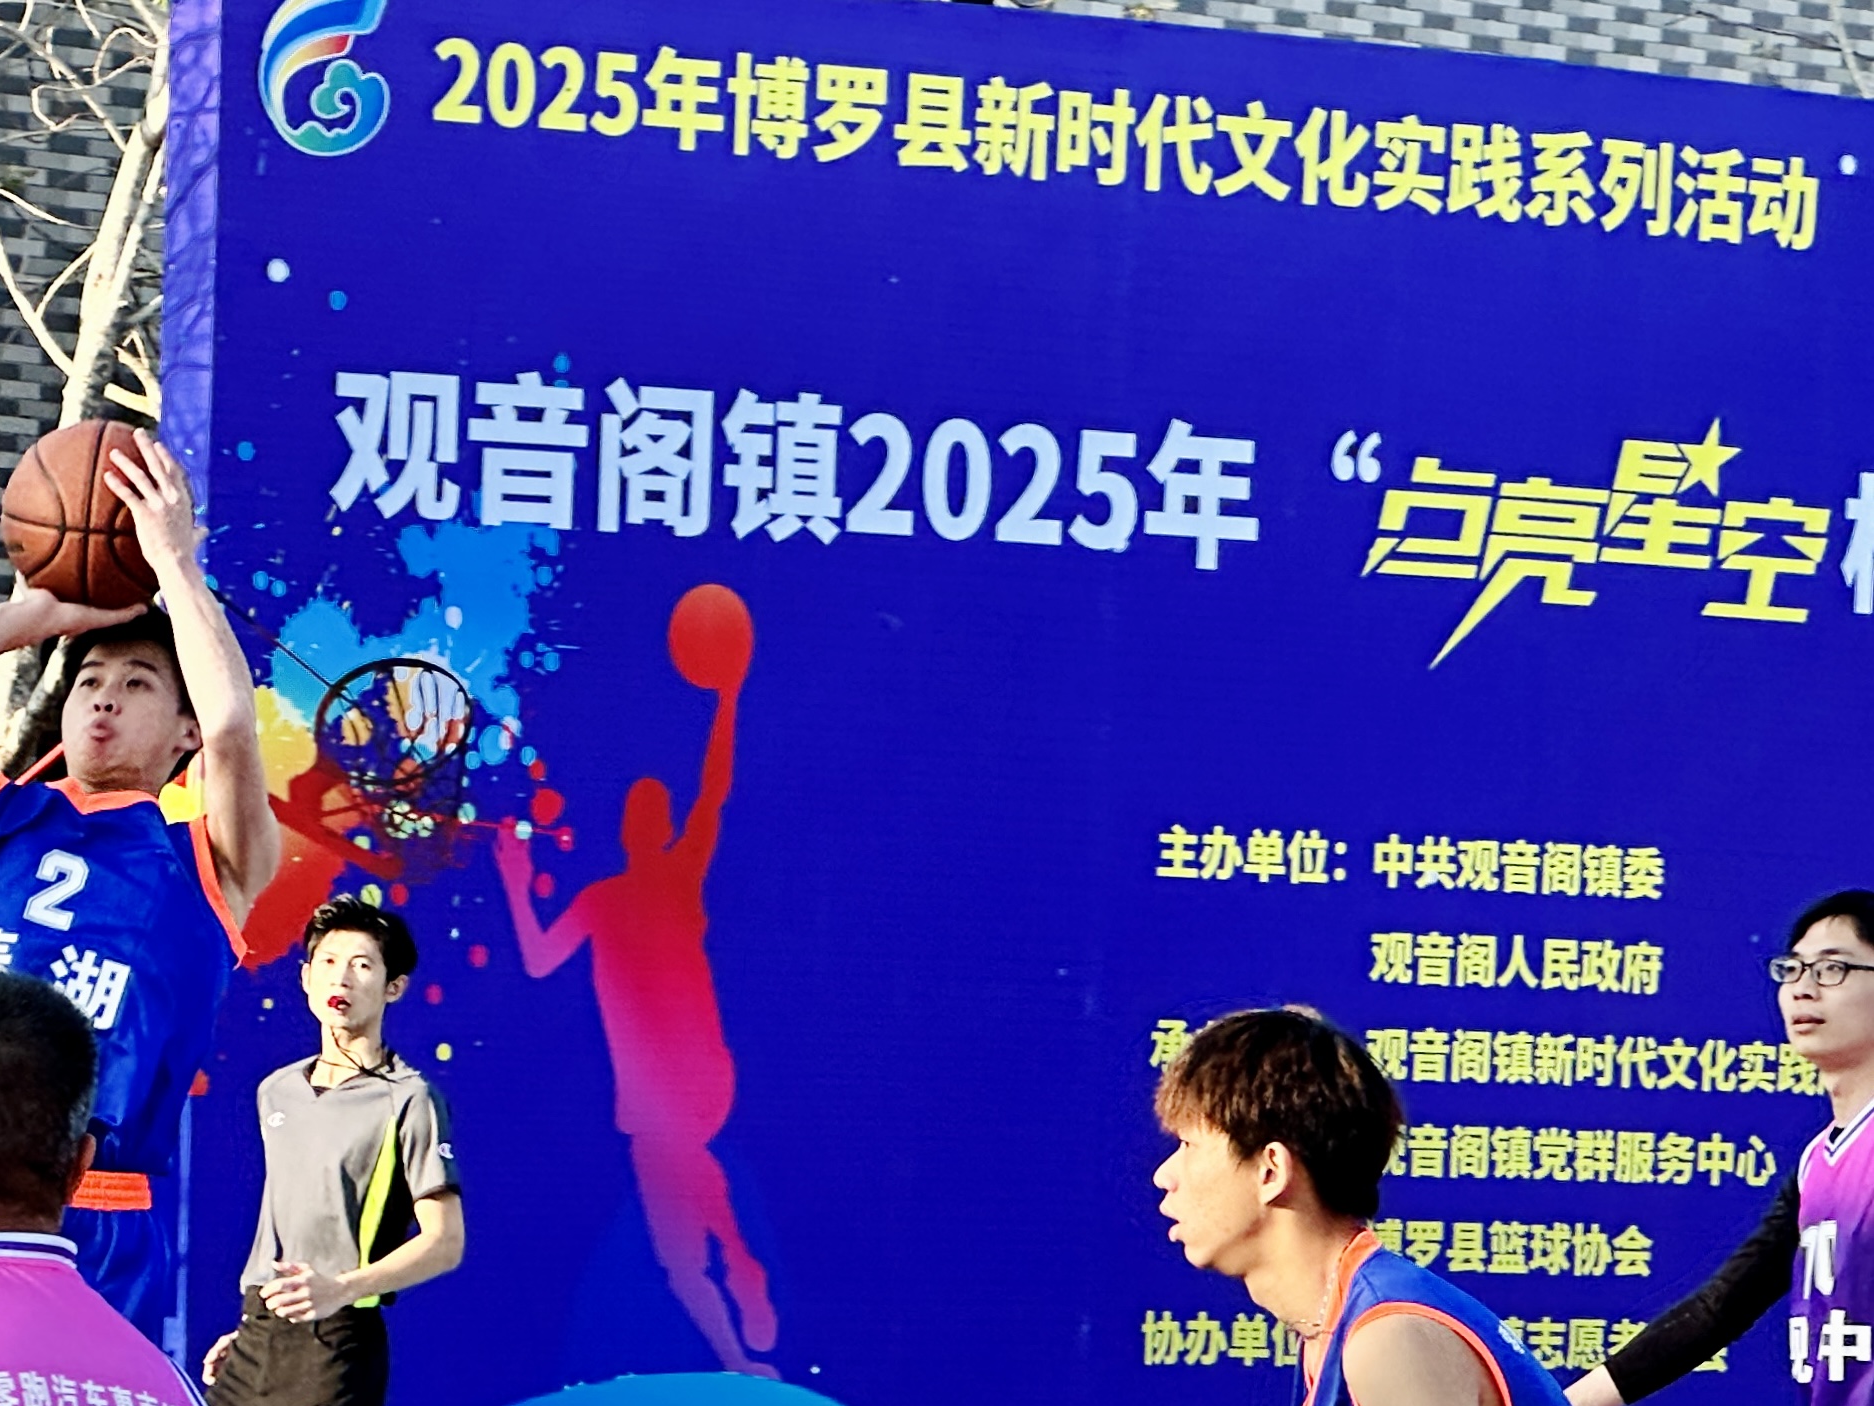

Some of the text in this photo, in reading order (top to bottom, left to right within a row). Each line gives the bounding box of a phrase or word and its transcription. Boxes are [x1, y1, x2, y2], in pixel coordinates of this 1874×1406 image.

[432, 37, 1820, 251] 2025年博罗县新时代文化实践系列活动
[328, 369, 1259, 572] 观音阁镇2025年
[23, 848, 90, 931] 2
[1156, 824, 1664, 899] 主办单位： 中共观音阁镇委
[1370, 932, 1664, 994] 观音阁人民政府
[1366, 1027, 1826, 1096] 观音阁镇新时代文化实践
